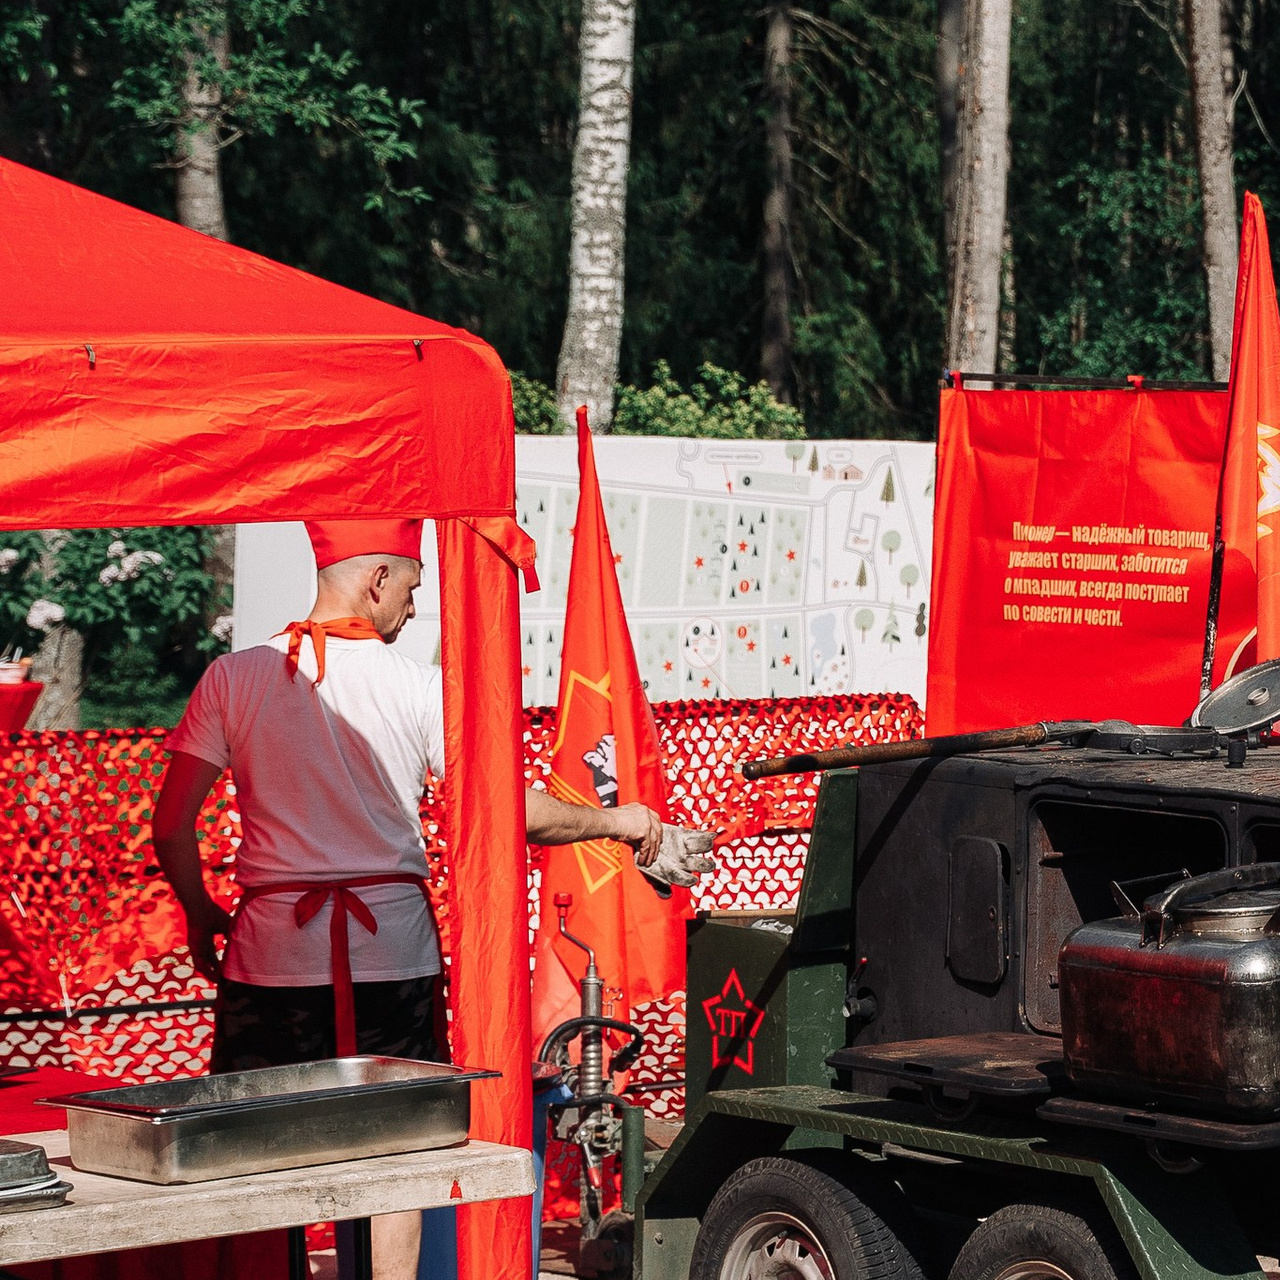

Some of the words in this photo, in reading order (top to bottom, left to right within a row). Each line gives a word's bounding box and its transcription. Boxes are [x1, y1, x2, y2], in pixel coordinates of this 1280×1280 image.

[1013, 521, 1057, 544] Пионер
[1072, 523, 1146, 546] надёжный
[1147, 528, 1211, 552] товарищ,
[1007, 550, 1059, 569] уважает
[1061, 552, 1120, 573] старших,
[1121, 552, 1189, 575] заботится
[1004, 577, 1013, 594] о
[1013, 578, 1078, 598] младших,
[1079, 580, 1123, 602] всегда
[1124, 583, 1190, 604] поступает
[1003, 604, 1020, 621] по
[1022, 605, 1072, 624] совести
[1073, 608, 1083, 624] и
[1084, 608, 1123, 627] чести.
[715, 1007, 748, 1039] ТП
